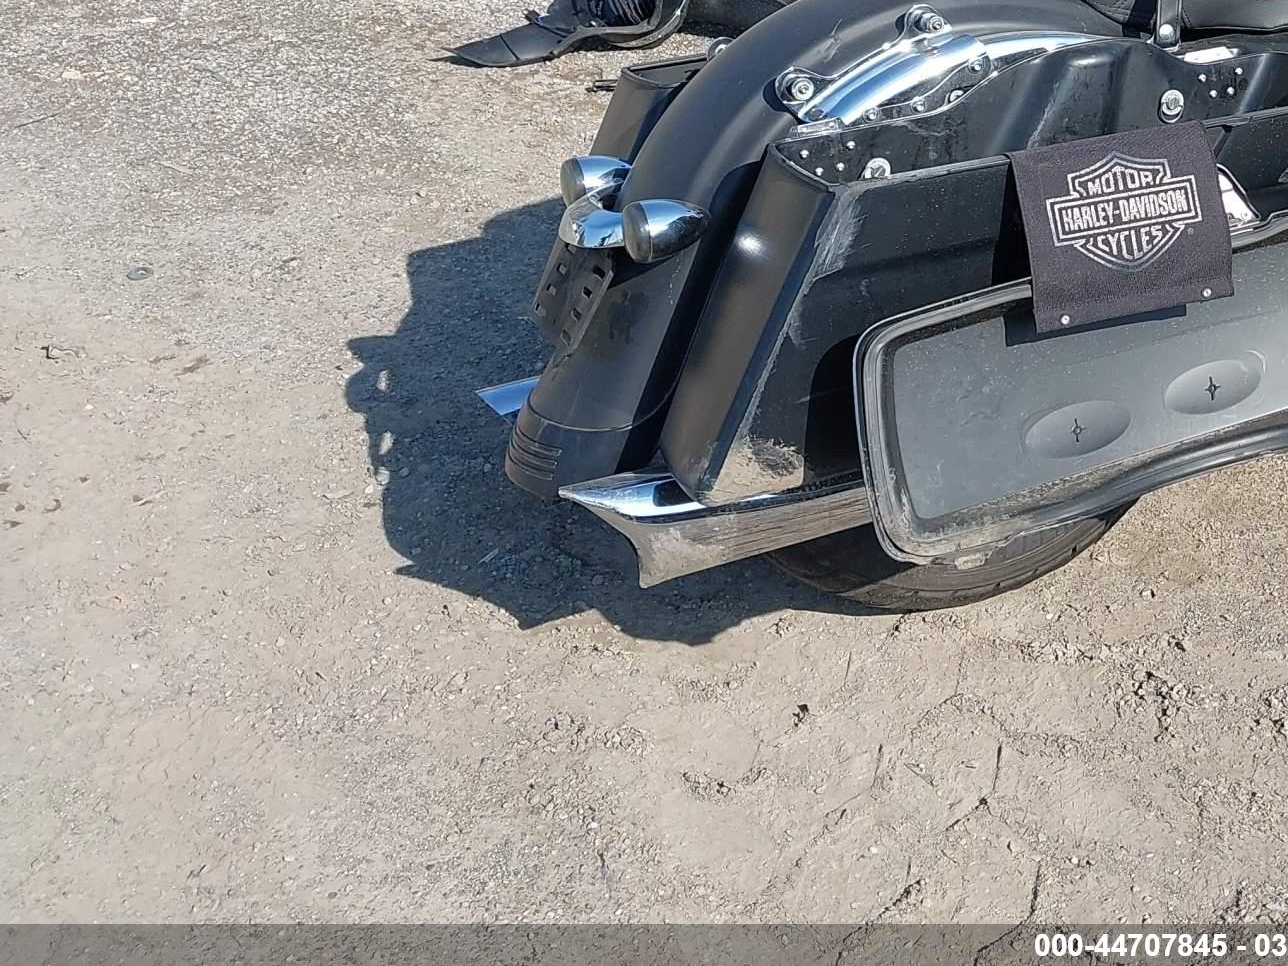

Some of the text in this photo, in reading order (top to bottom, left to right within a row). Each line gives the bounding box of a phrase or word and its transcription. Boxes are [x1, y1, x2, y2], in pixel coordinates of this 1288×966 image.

[1088, 166, 1154, 196] MOTOR
[1062, 189, 1188, 232] HARLEY-DAVIDSON
[1097, 224, 1163, 260] CYCLES
